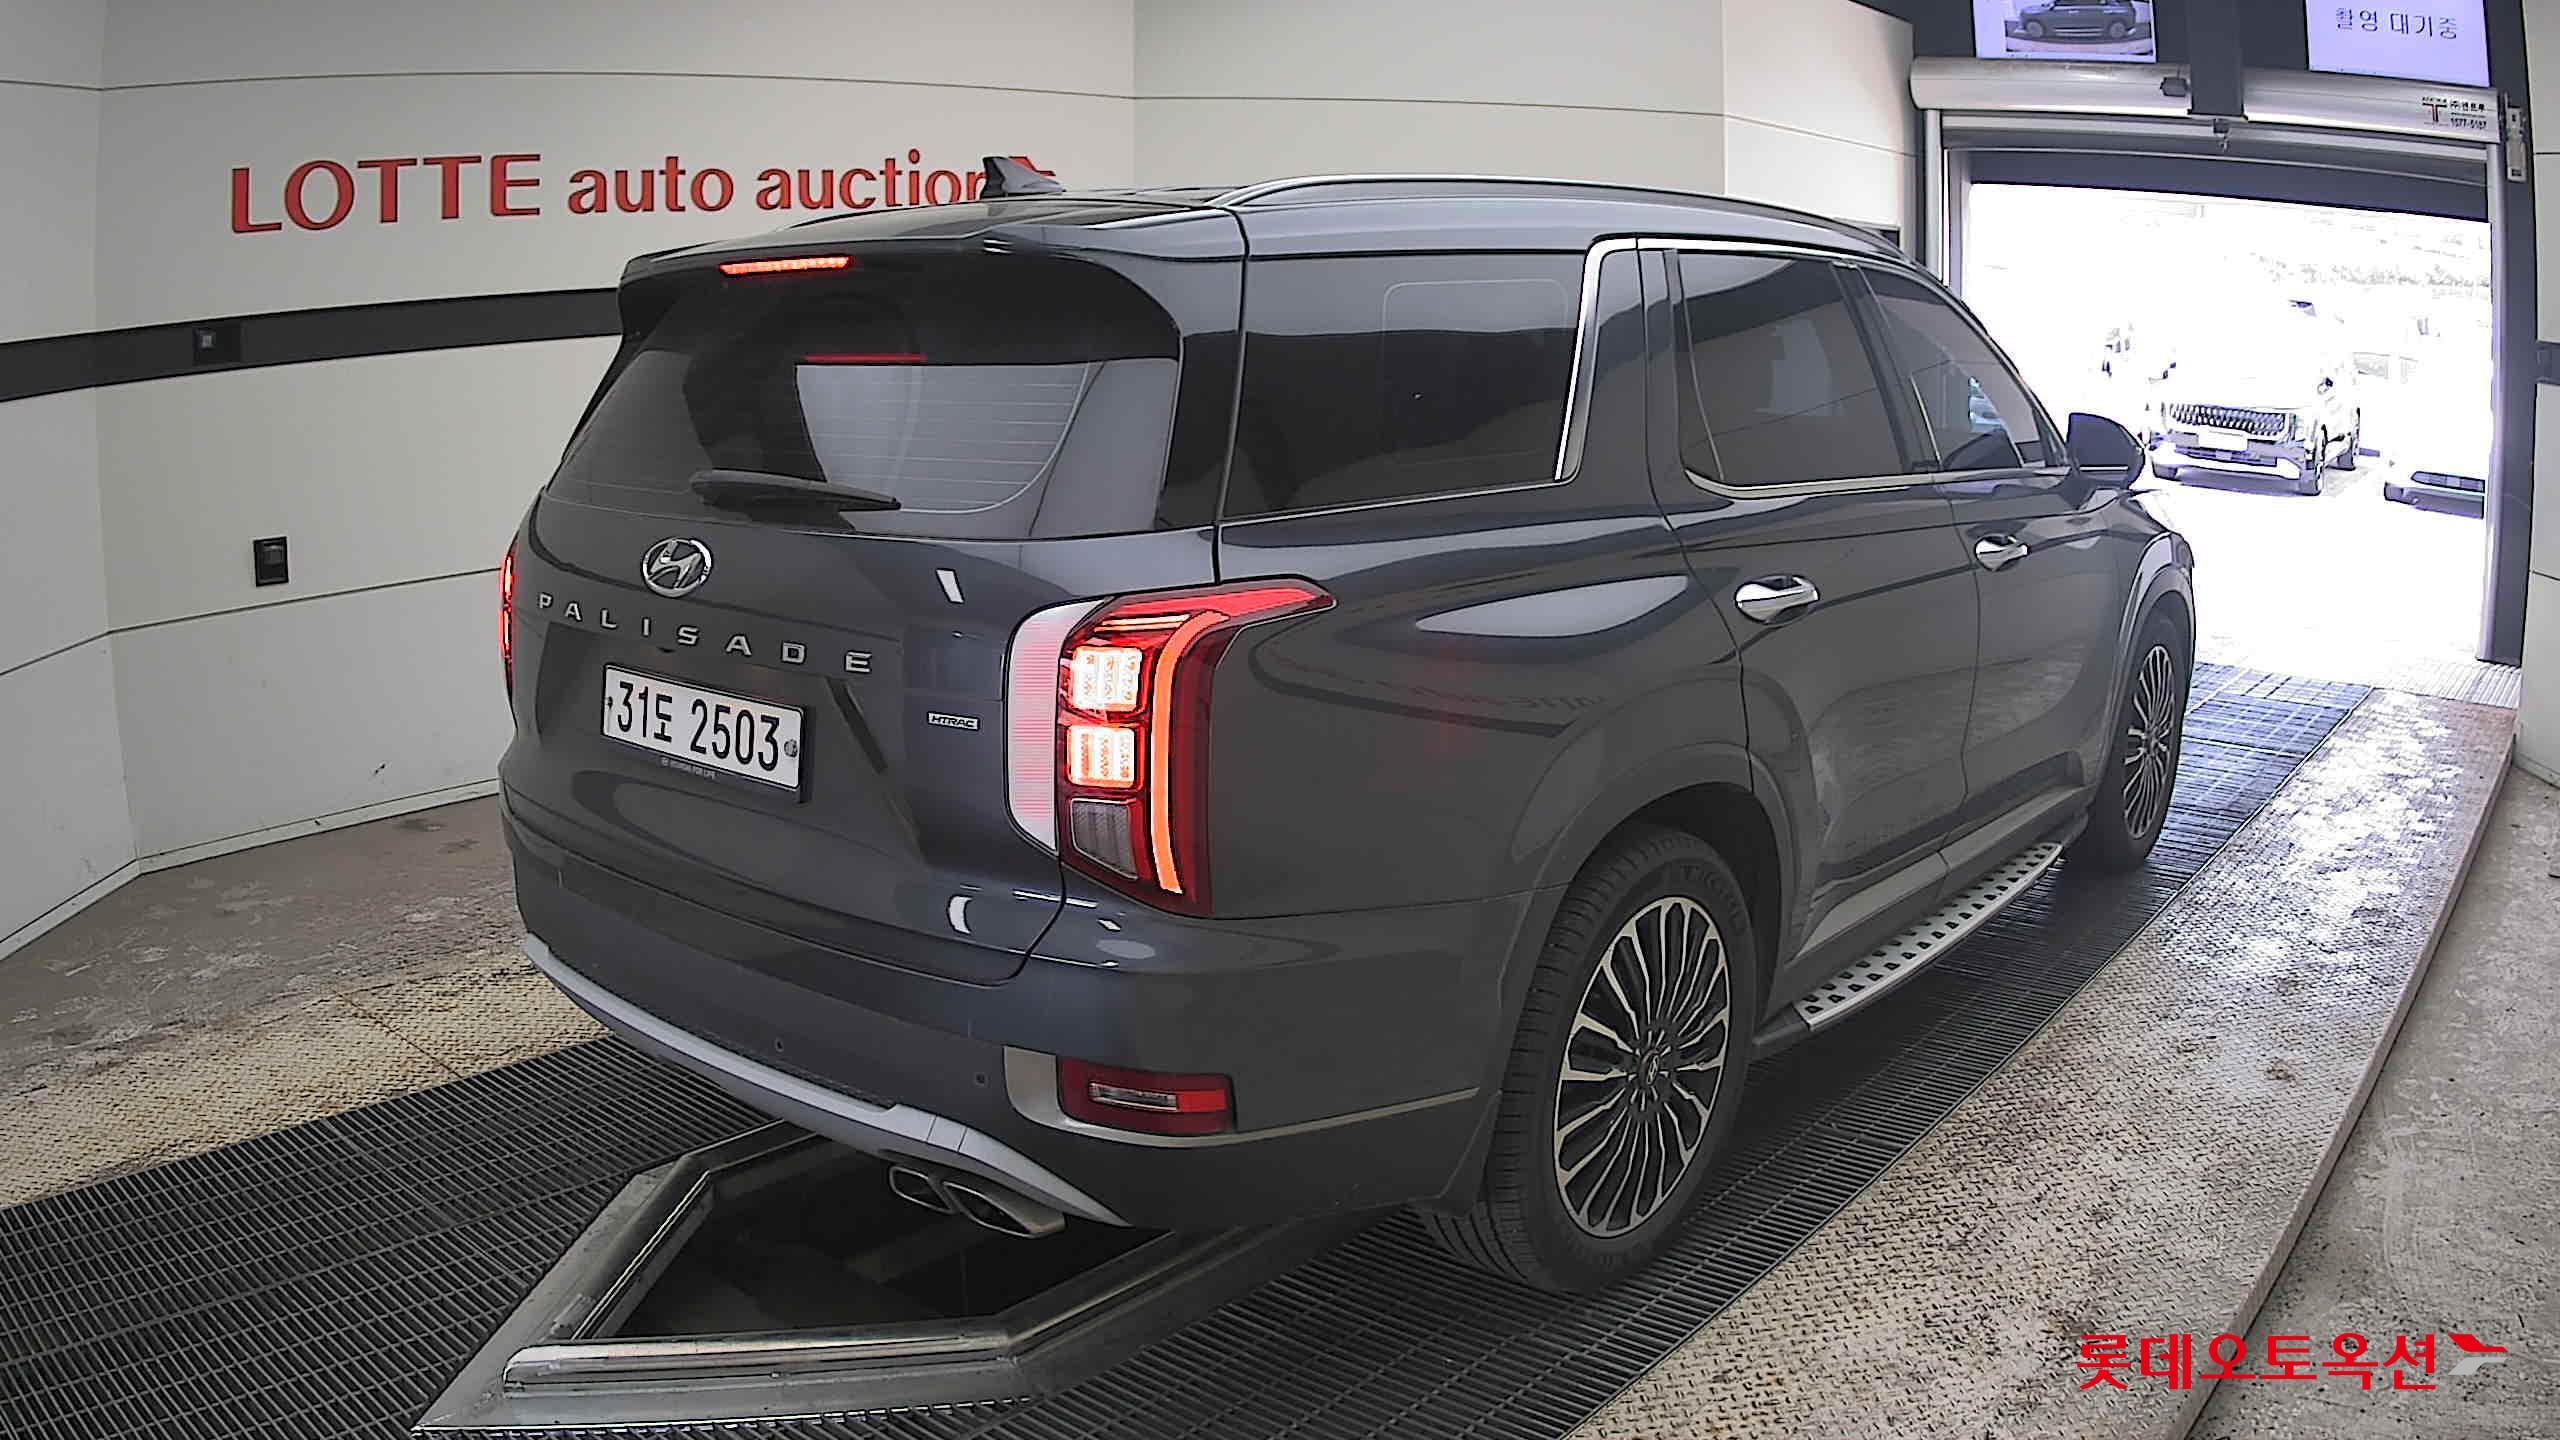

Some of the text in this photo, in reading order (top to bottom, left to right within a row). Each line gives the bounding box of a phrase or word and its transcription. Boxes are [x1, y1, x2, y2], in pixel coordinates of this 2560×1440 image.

[232, 153, 541, 234] LOTTE
[568, 156, 735, 214] auto
[538, 592, 873, 674] PALISADE
[617, 680, 780, 772] 31도 2503
[929, 714, 979, 730] HTRAC
